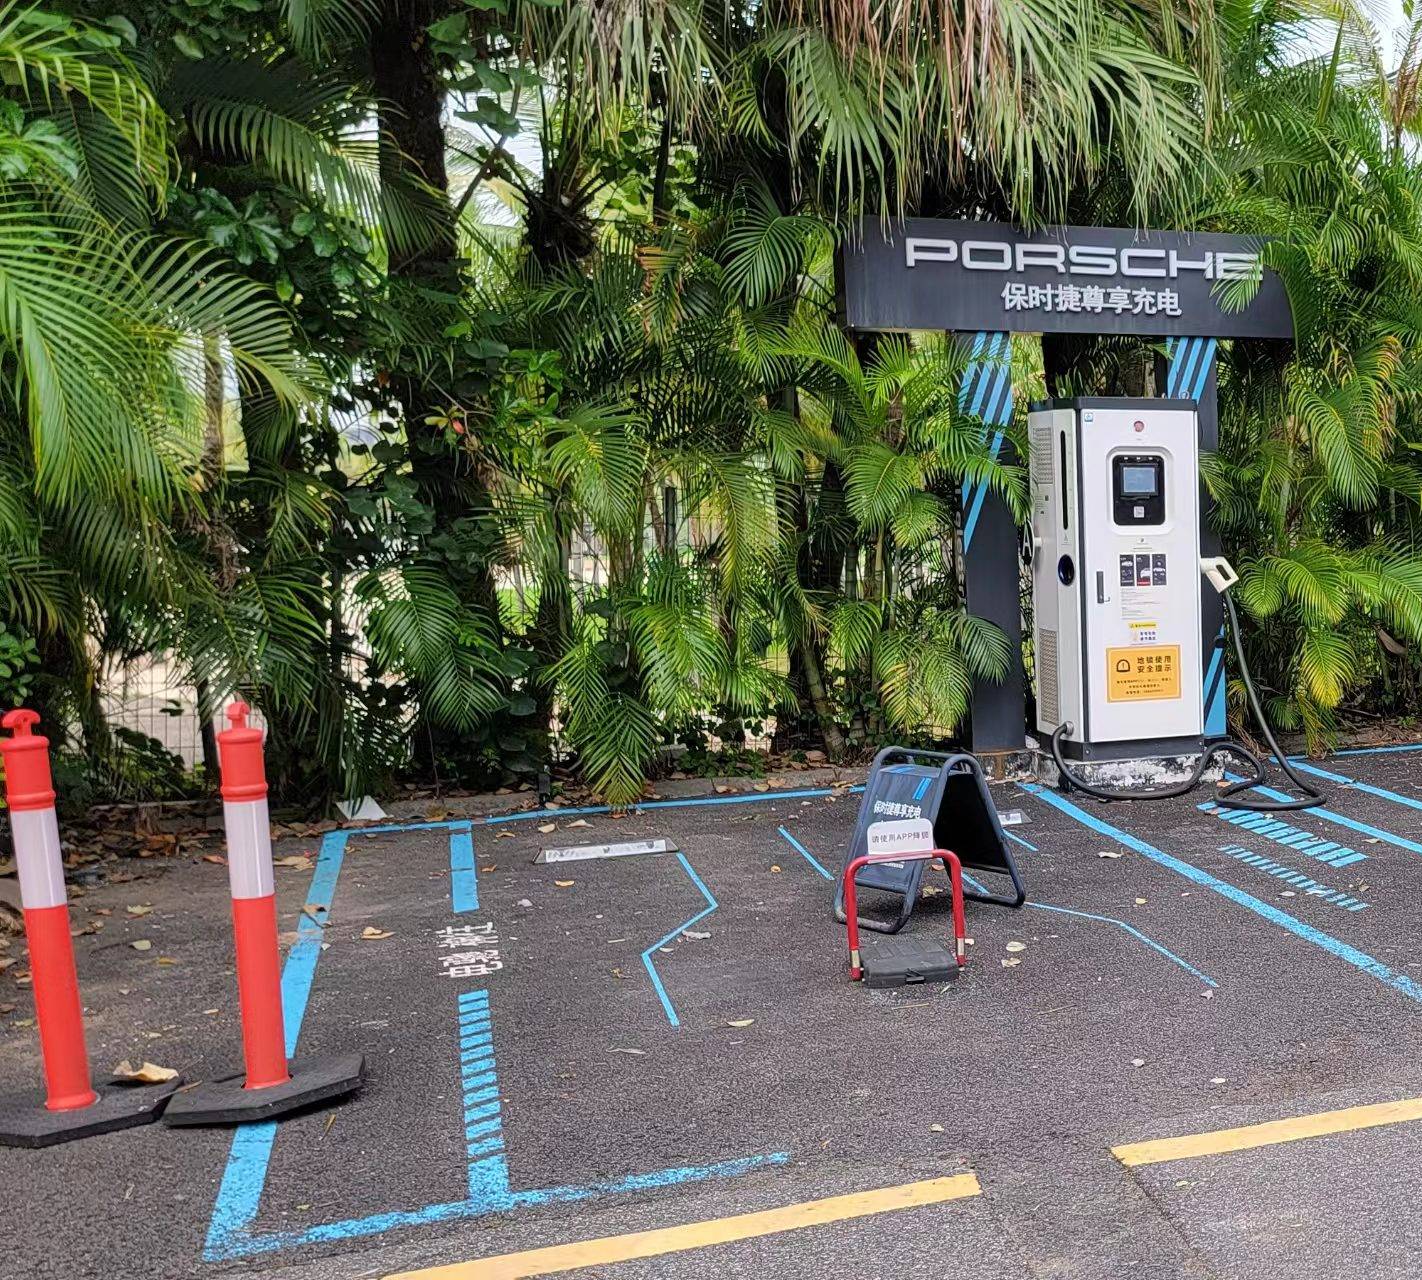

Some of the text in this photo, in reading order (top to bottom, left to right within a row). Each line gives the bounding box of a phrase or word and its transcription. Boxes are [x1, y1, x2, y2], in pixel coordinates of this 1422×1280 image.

[905, 237, 1263, 281] PORSCHE
[1001, 281, 1182, 317] 保时捷尊享充电
[1137, 664, 1172, 674] 安全提示
[873, 800, 922, 819] 保时捷尊享充电
